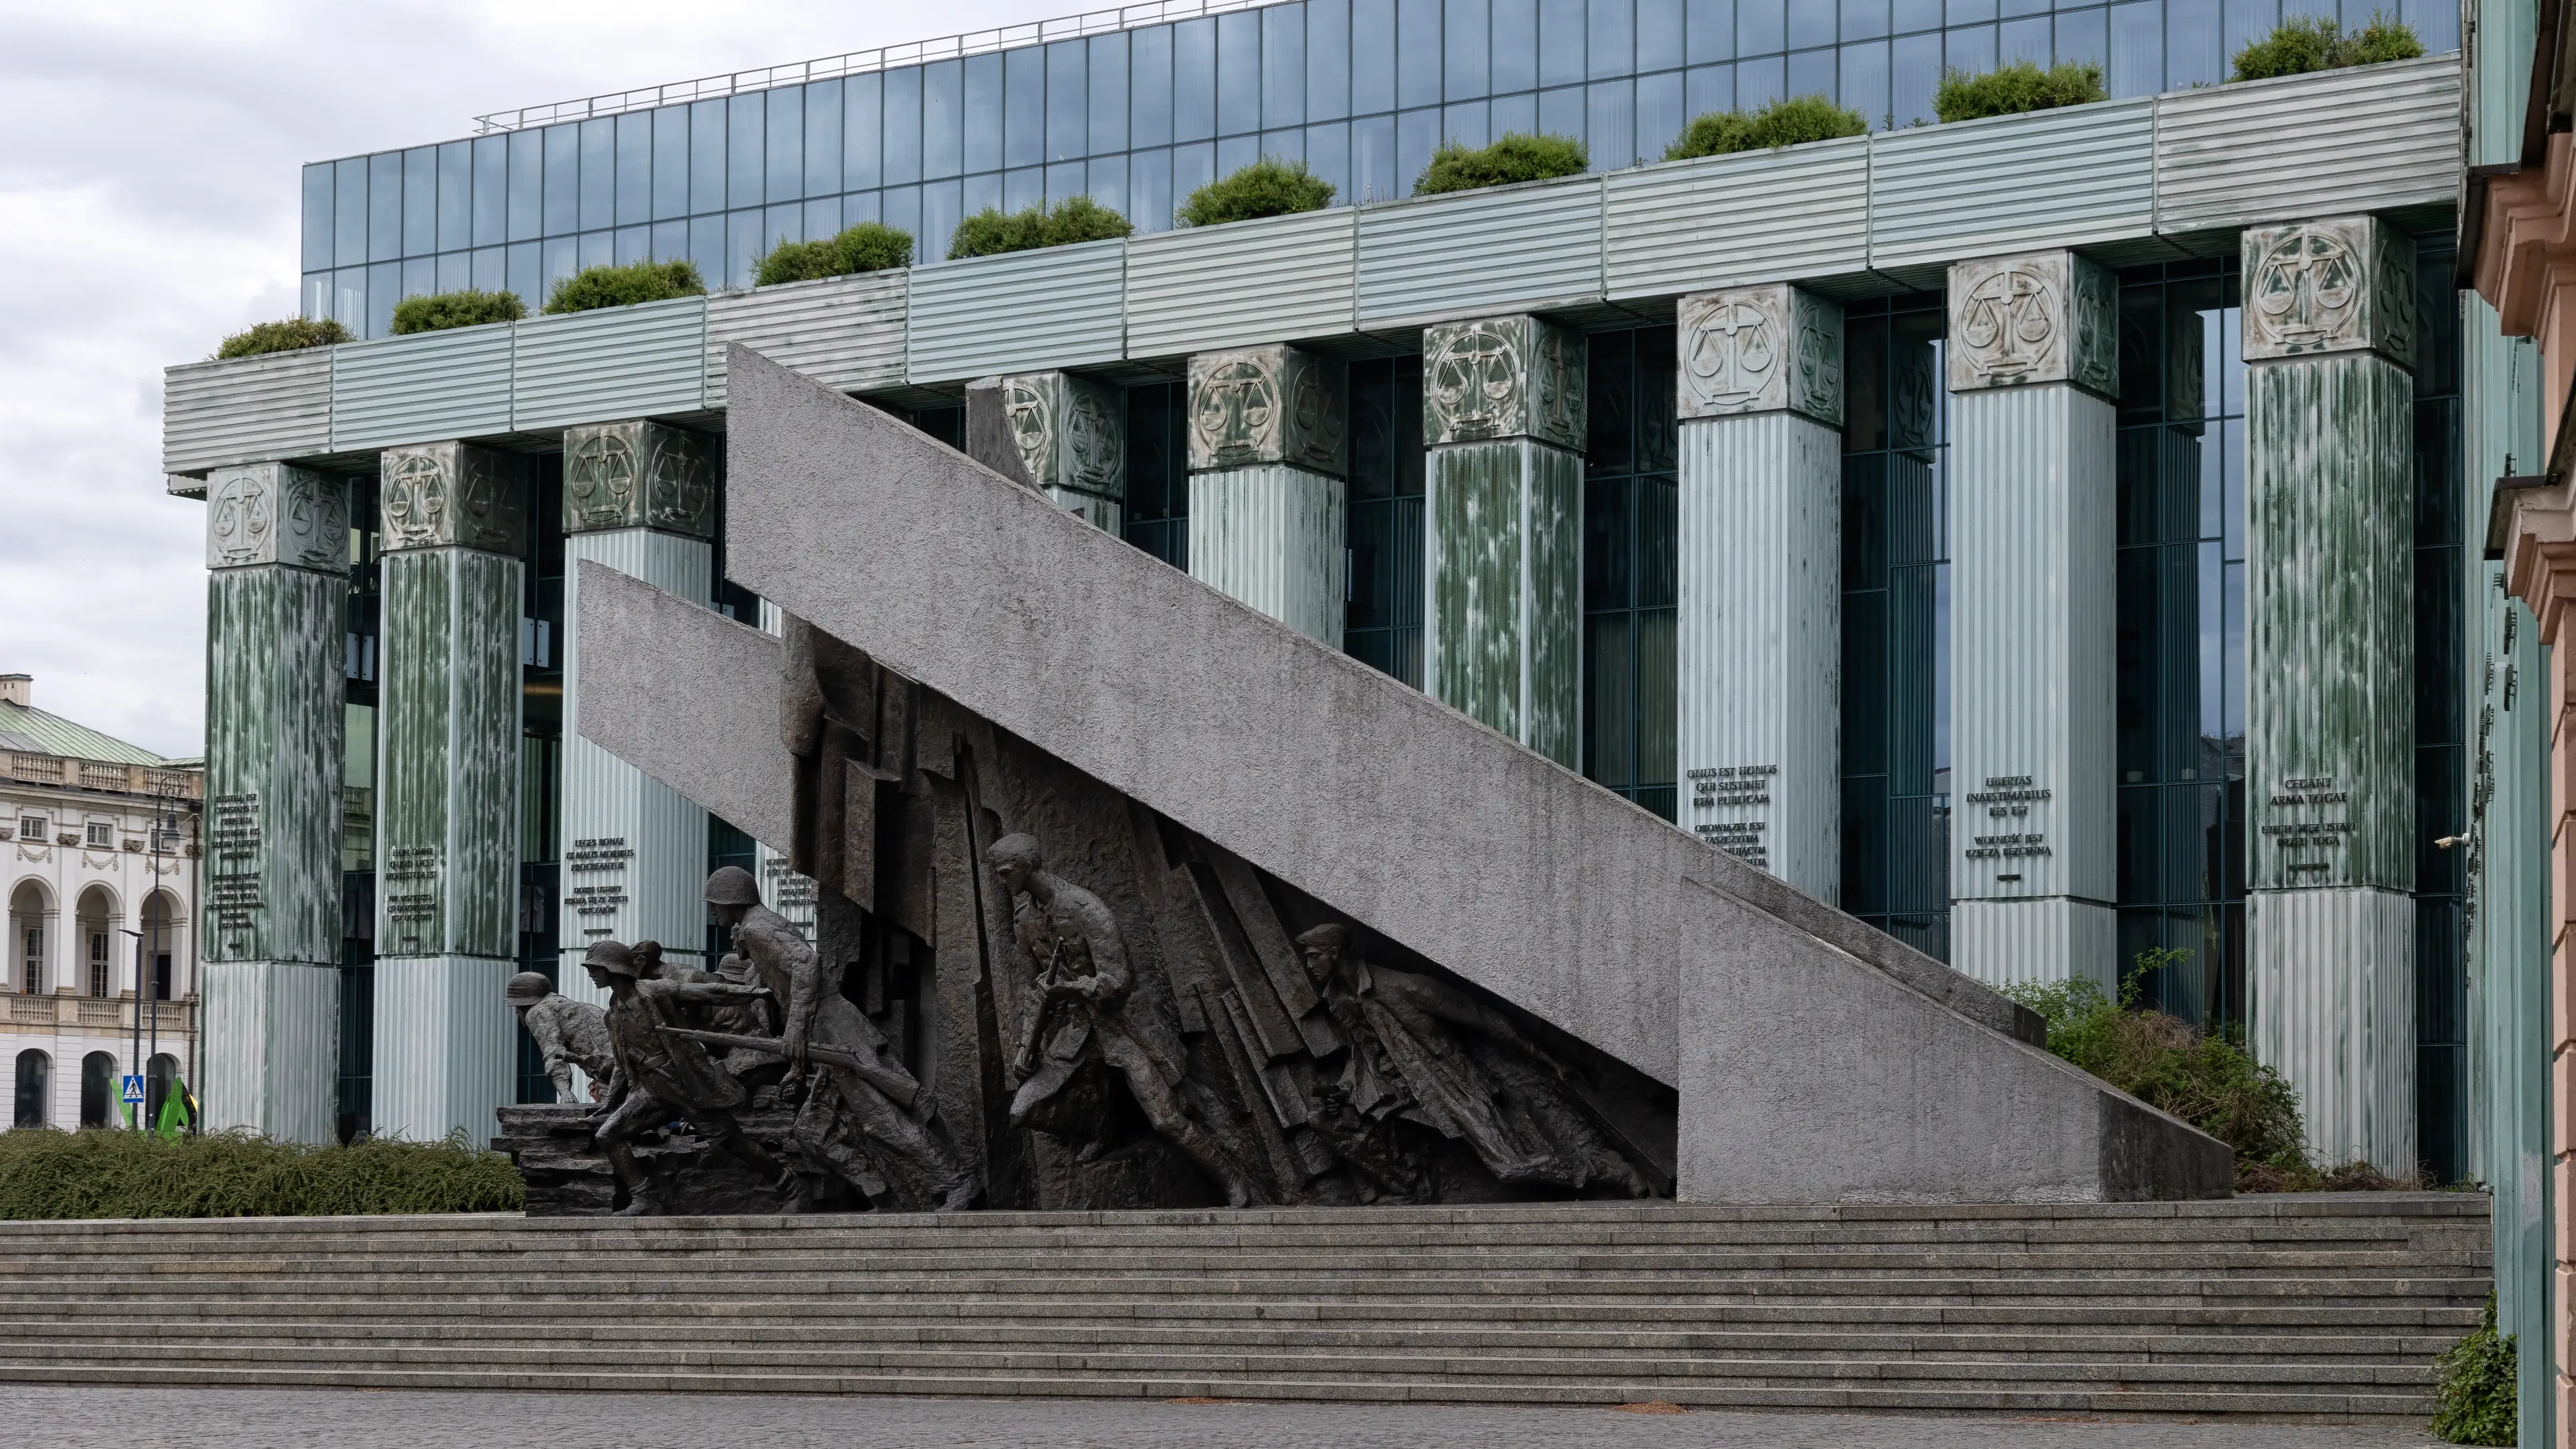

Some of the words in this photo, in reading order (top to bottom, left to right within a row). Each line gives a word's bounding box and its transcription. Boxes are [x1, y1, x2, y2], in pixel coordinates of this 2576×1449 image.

[1687, 767, 1717, 778] ONUS
[1719, 767, 1736, 777] EST
[1739, 764, 1778, 775] HONOS
[1986, 775, 2032, 787] LIBERTAS
[2284, 777, 2332, 790] CEDANT
[1696, 782, 1717, 794] QUI
[1719, 780, 1766, 791] SUSTINET
[246, 794, 257, 802] EST
[1693, 797, 1715, 807] REM
[1717, 794, 1770, 805] PUBLICAM
[1966, 789, 2051, 802] INAESTIMABILIS
[2271, 795, 2304, 805] ARMA
[2306, 792, 2348, 804] TOGAE
[1989, 806, 2008, 816] RES
[2011, 806, 2029, 816] EST
[220, 817, 253, 825] PERPETUA
[1695, 822, 1748, 833] OBOWIĄZEK
[1748, 822, 1766, 832] JEST
[2261, 825, 2292, 834] NIECH
[2322, 822, 2356, 833] USTĄPI
[212, 841, 233, 849] SUUM
[234, 839, 262, 848] CUIQUE
[575, 839, 597, 847] LEGES
[598, 838, 625, 847] BONAE
[1974, 833, 2023, 845] WOLNOŚĆ
[2025, 833, 2043, 844] JEST
[2277, 837, 2307, 847] PRZED
[2312, 837, 2341, 847] TOGĄ
[392, 849, 409, 857] NON
[566, 852, 575, 860] EX
[575, 851, 598, 859] MALIS
[599, 849, 635, 859] MORIBUS
[1966, 848, 2000, 859] RZECZĄ
[2003, 846, 2052, 857] BEZCENNĄ
[390, 861, 413, 869] QUOD
[415, 859, 435, 867] LICET
[571, 862, 625, 872] PROCREANTUR
[386, 872, 425, 880] HONESTUM
[574, 886, 596, 894] DOBRE
[564, 898, 587, 906] RODZĄ
[588, 896, 597, 904] SIĘ
[578, 905, 617, 915] OBYCZAJÓW
